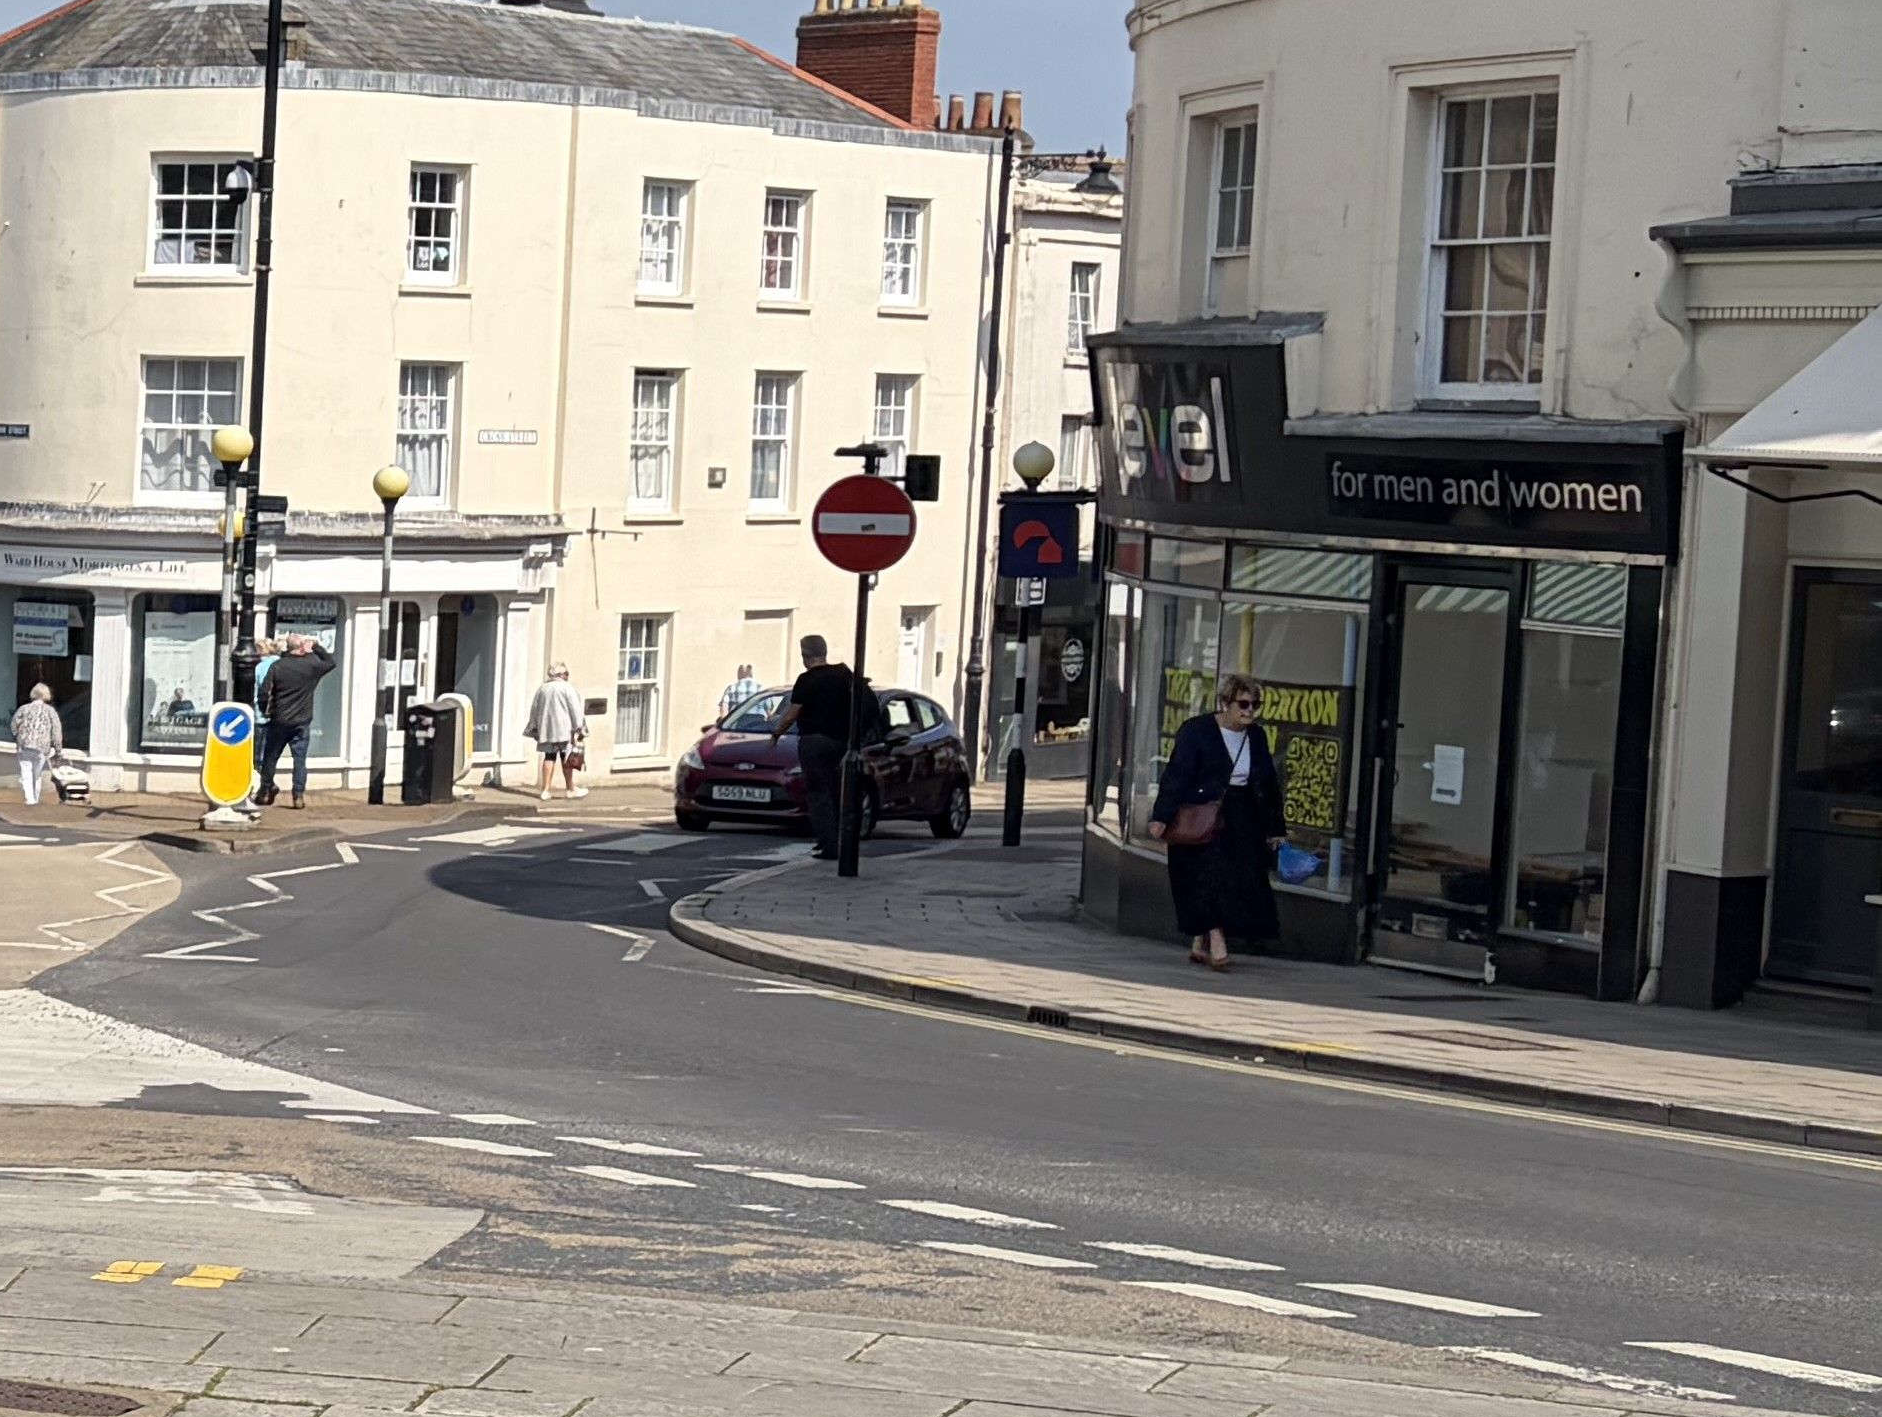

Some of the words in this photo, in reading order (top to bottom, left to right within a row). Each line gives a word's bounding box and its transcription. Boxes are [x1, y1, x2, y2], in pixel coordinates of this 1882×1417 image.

[1331, 460, 1367, 499] for
[1373, 473, 1434, 504] men
[1442, 469, 1501, 507] and
[1509, 480, 1643, 513] women
[1254, 685, 1340, 726] CATION
